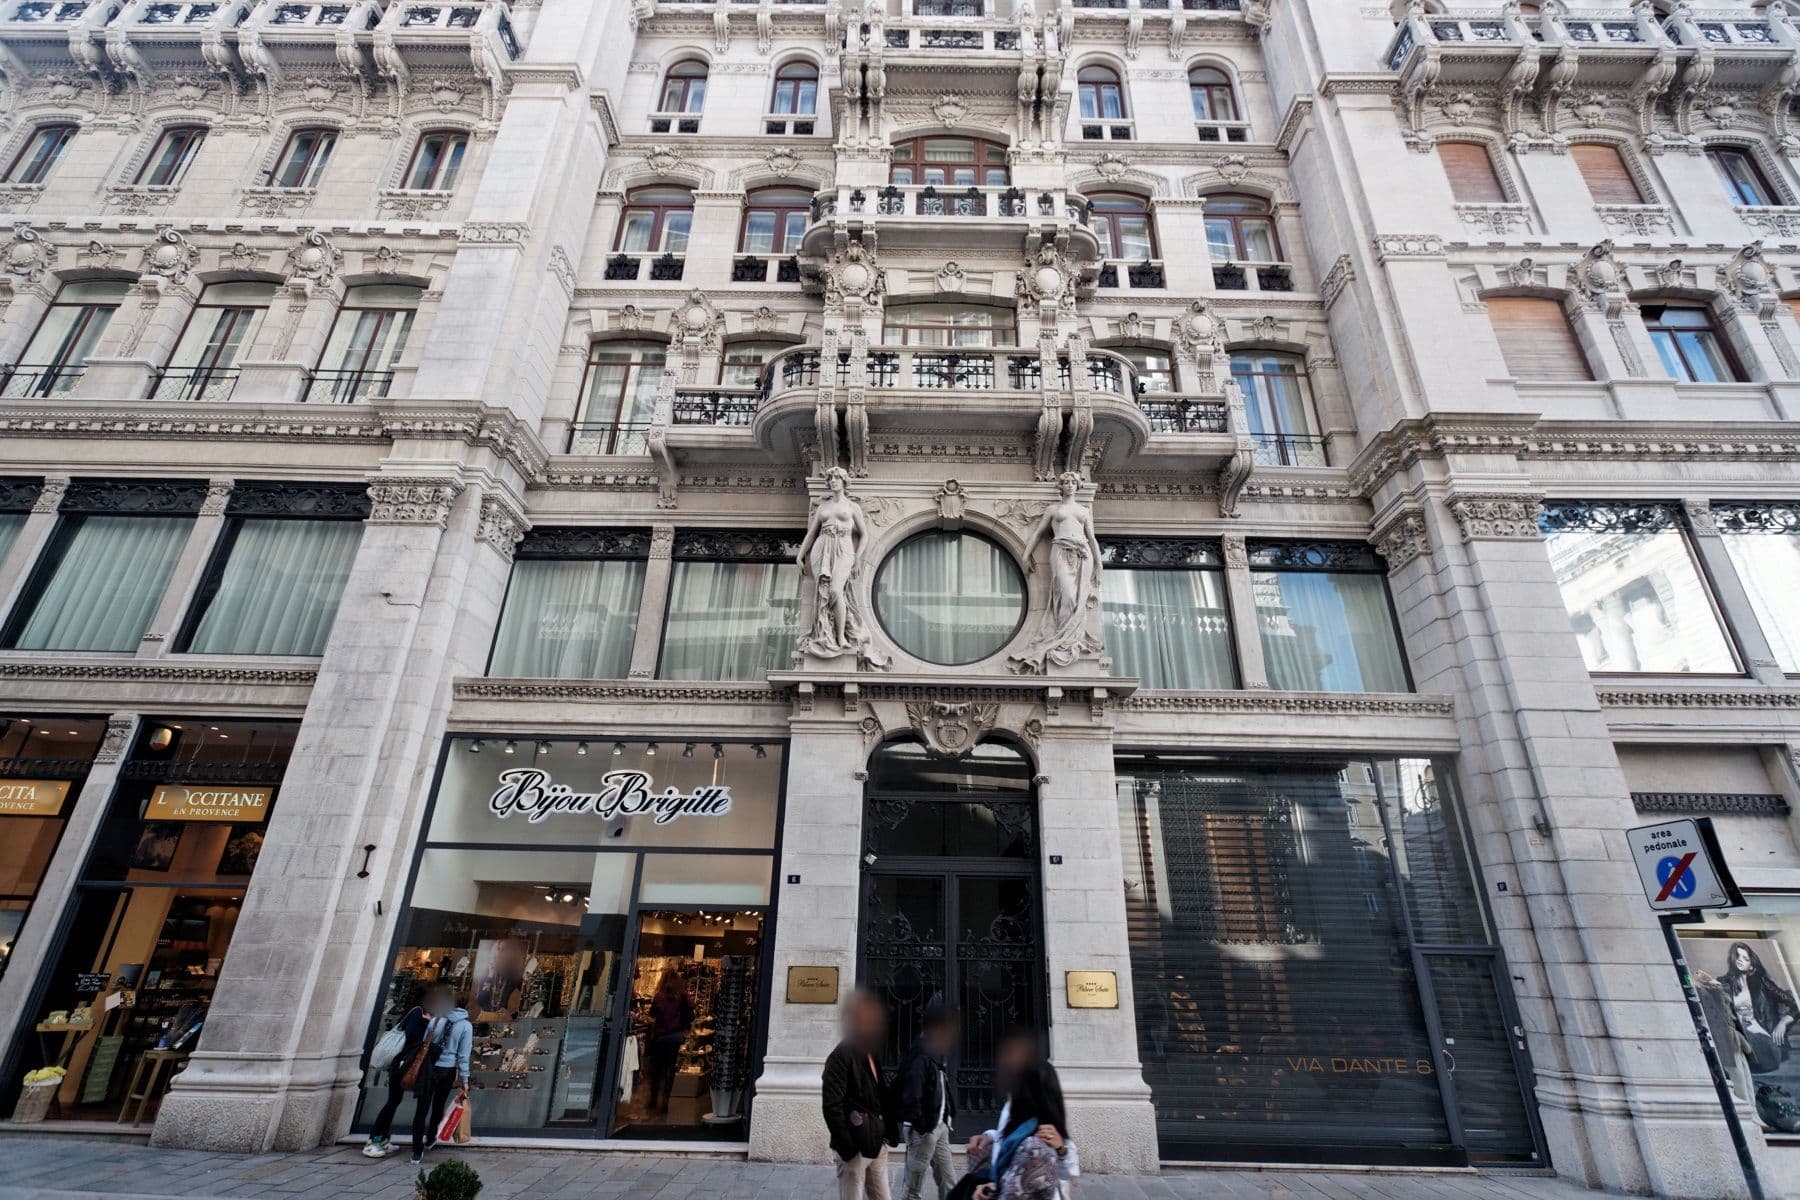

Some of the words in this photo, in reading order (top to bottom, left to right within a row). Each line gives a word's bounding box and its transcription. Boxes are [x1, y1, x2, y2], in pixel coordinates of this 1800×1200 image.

[491, 769, 592, 821] Bijou
[594, 771, 730, 824] Brigitte
[173, 807, 186, 816] EN
[188, 808, 240, 817] PROVENCE
[1650, 829, 1673, 840] area
[1643, 839, 1688, 855] pedonale
[1286, 1057, 1325, 1072] VIA
[1331, 1058, 1409, 1074] DANTE
[1416, 1060, 1432, 1075] 6
